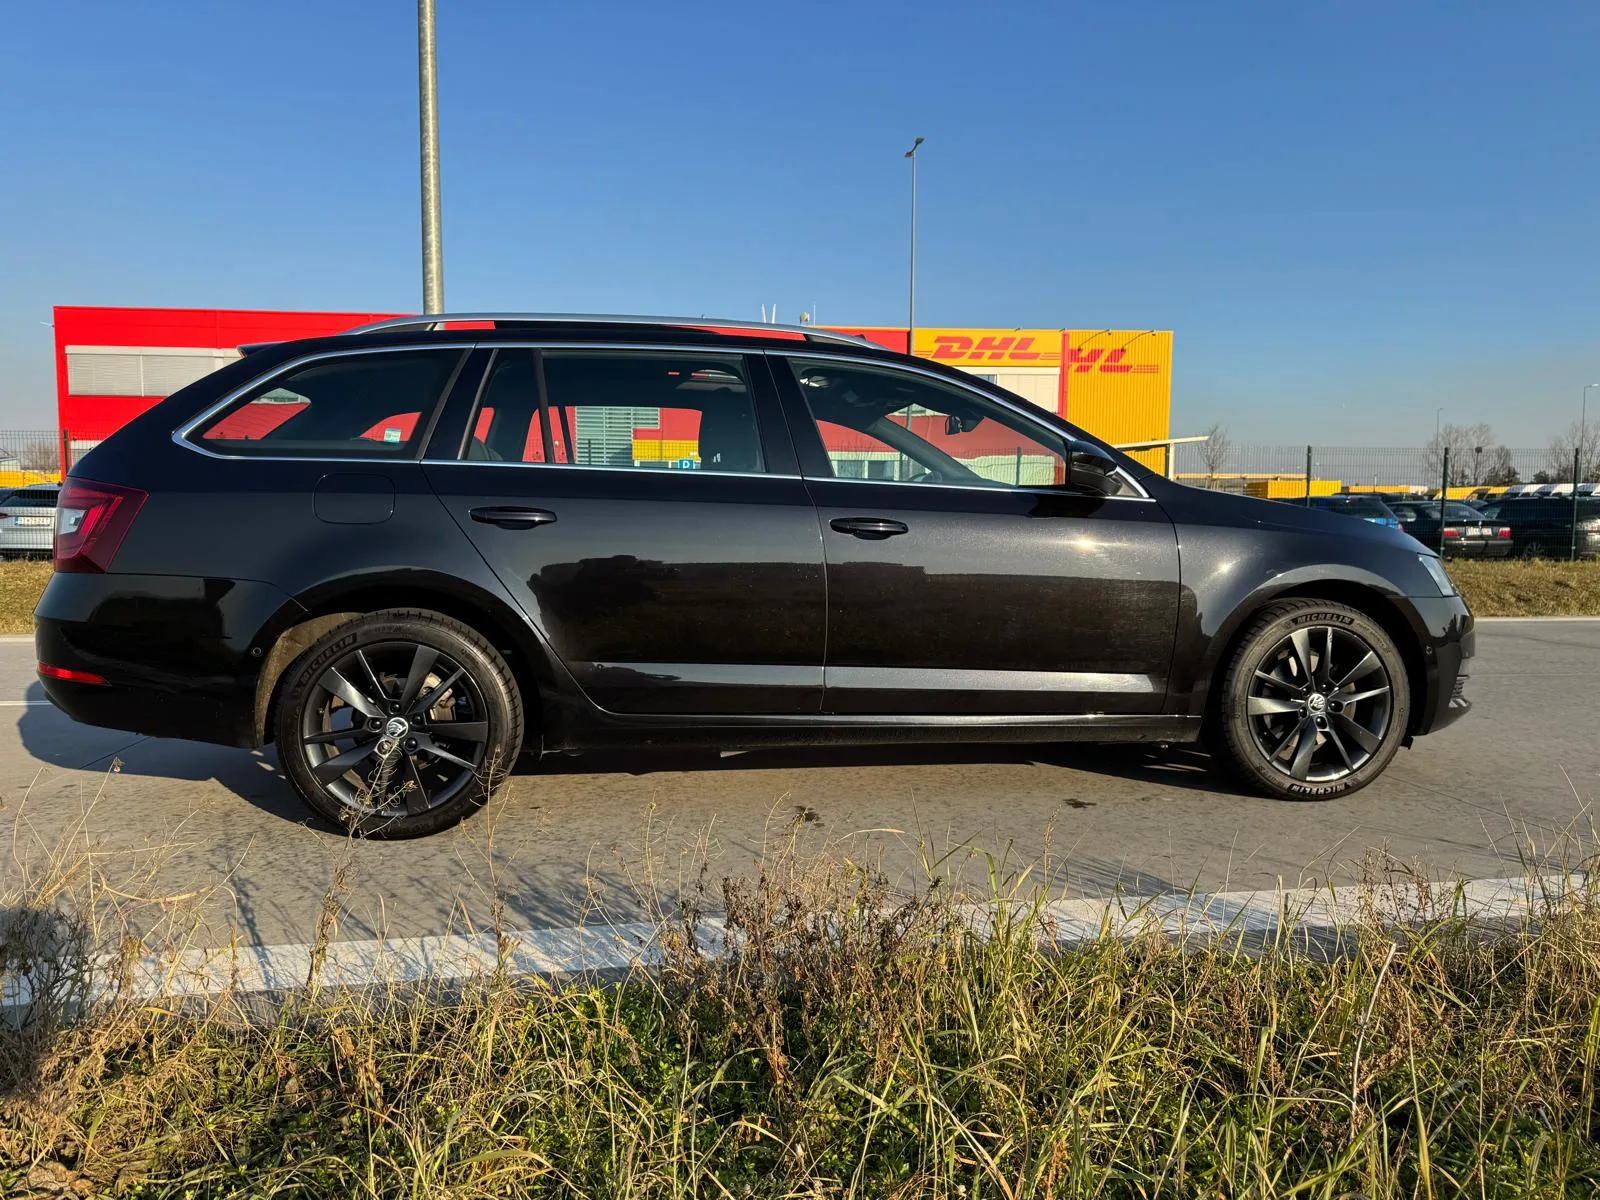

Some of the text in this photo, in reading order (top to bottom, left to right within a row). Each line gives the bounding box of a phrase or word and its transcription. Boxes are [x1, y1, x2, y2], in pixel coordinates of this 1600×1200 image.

[931, 336, 1041, 360] DHL
[1068, 348, 1133, 373] HL
[1297, 612, 1351, 625] MICHELIN
[300, 634, 354, 684] MICHELIN
[1291, 783, 1346, 795] MICHELIN
